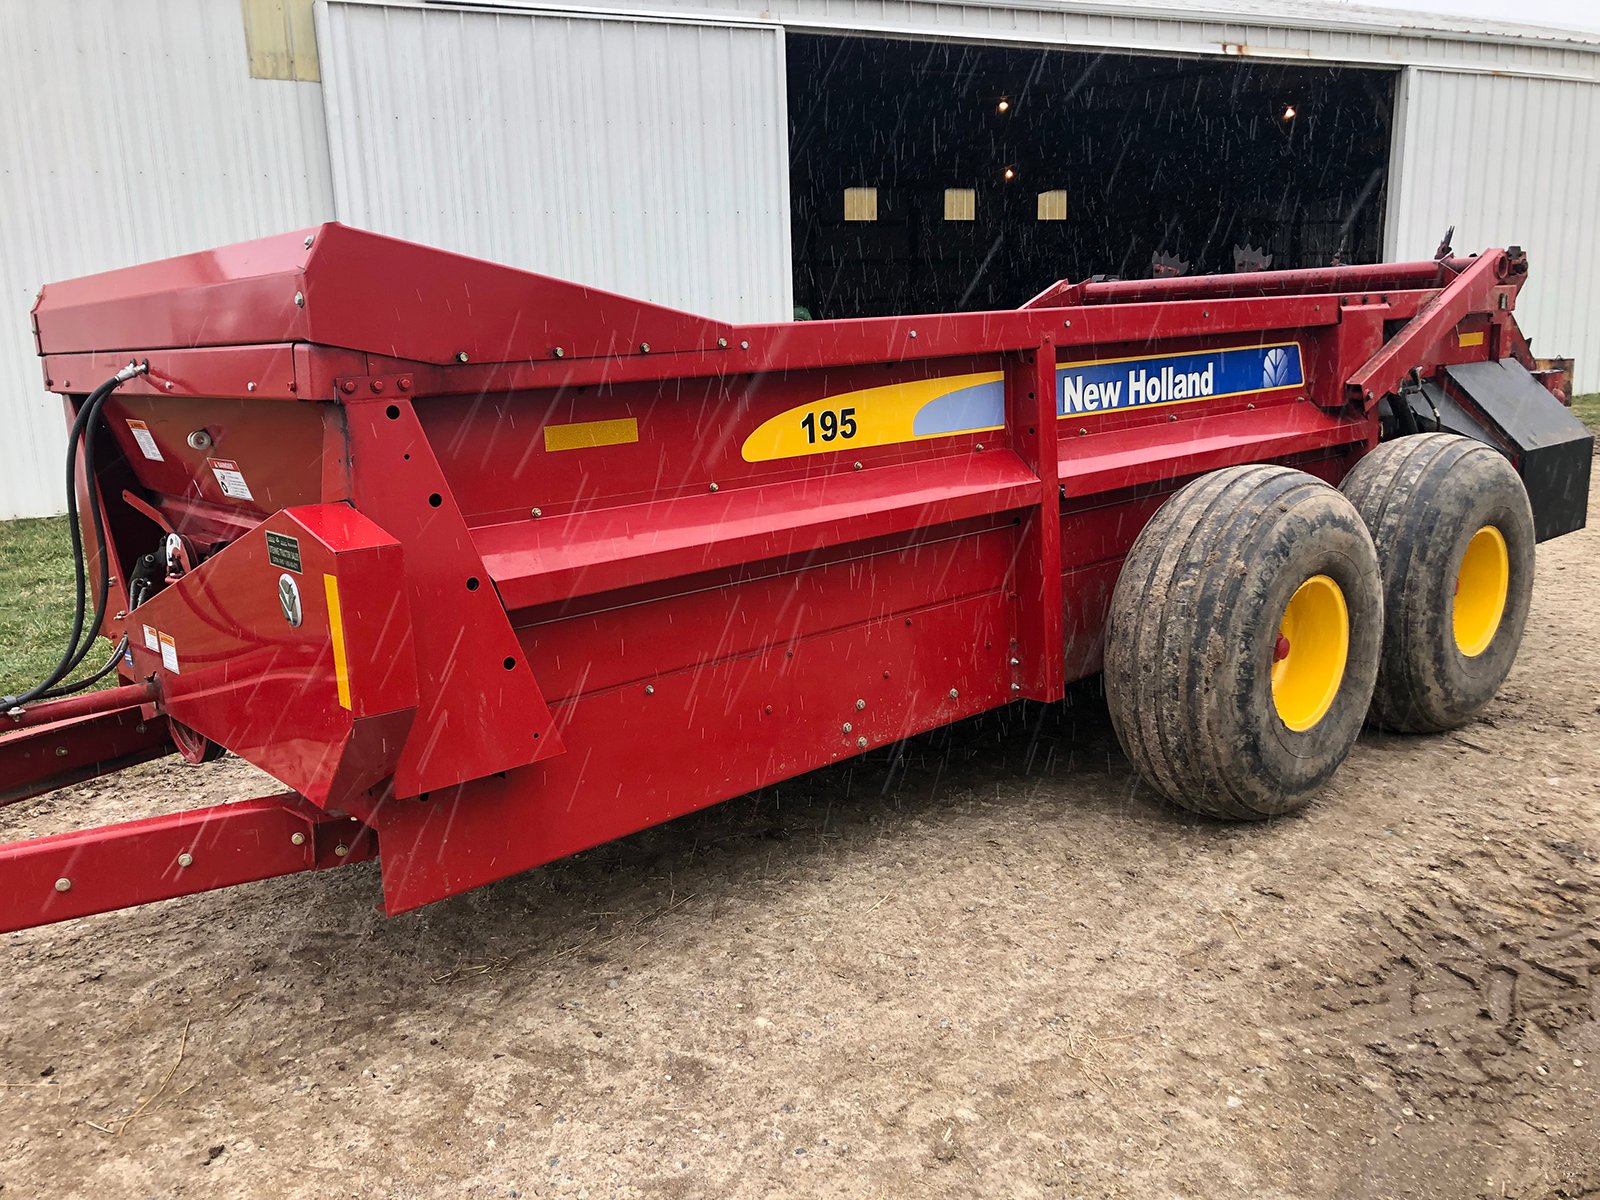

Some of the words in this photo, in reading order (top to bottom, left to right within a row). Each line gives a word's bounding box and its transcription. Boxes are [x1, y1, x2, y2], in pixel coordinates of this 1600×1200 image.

[1064, 375, 1122, 413] New
[1128, 362, 1214, 405] Holland
[801, 408, 857, 444] 195
